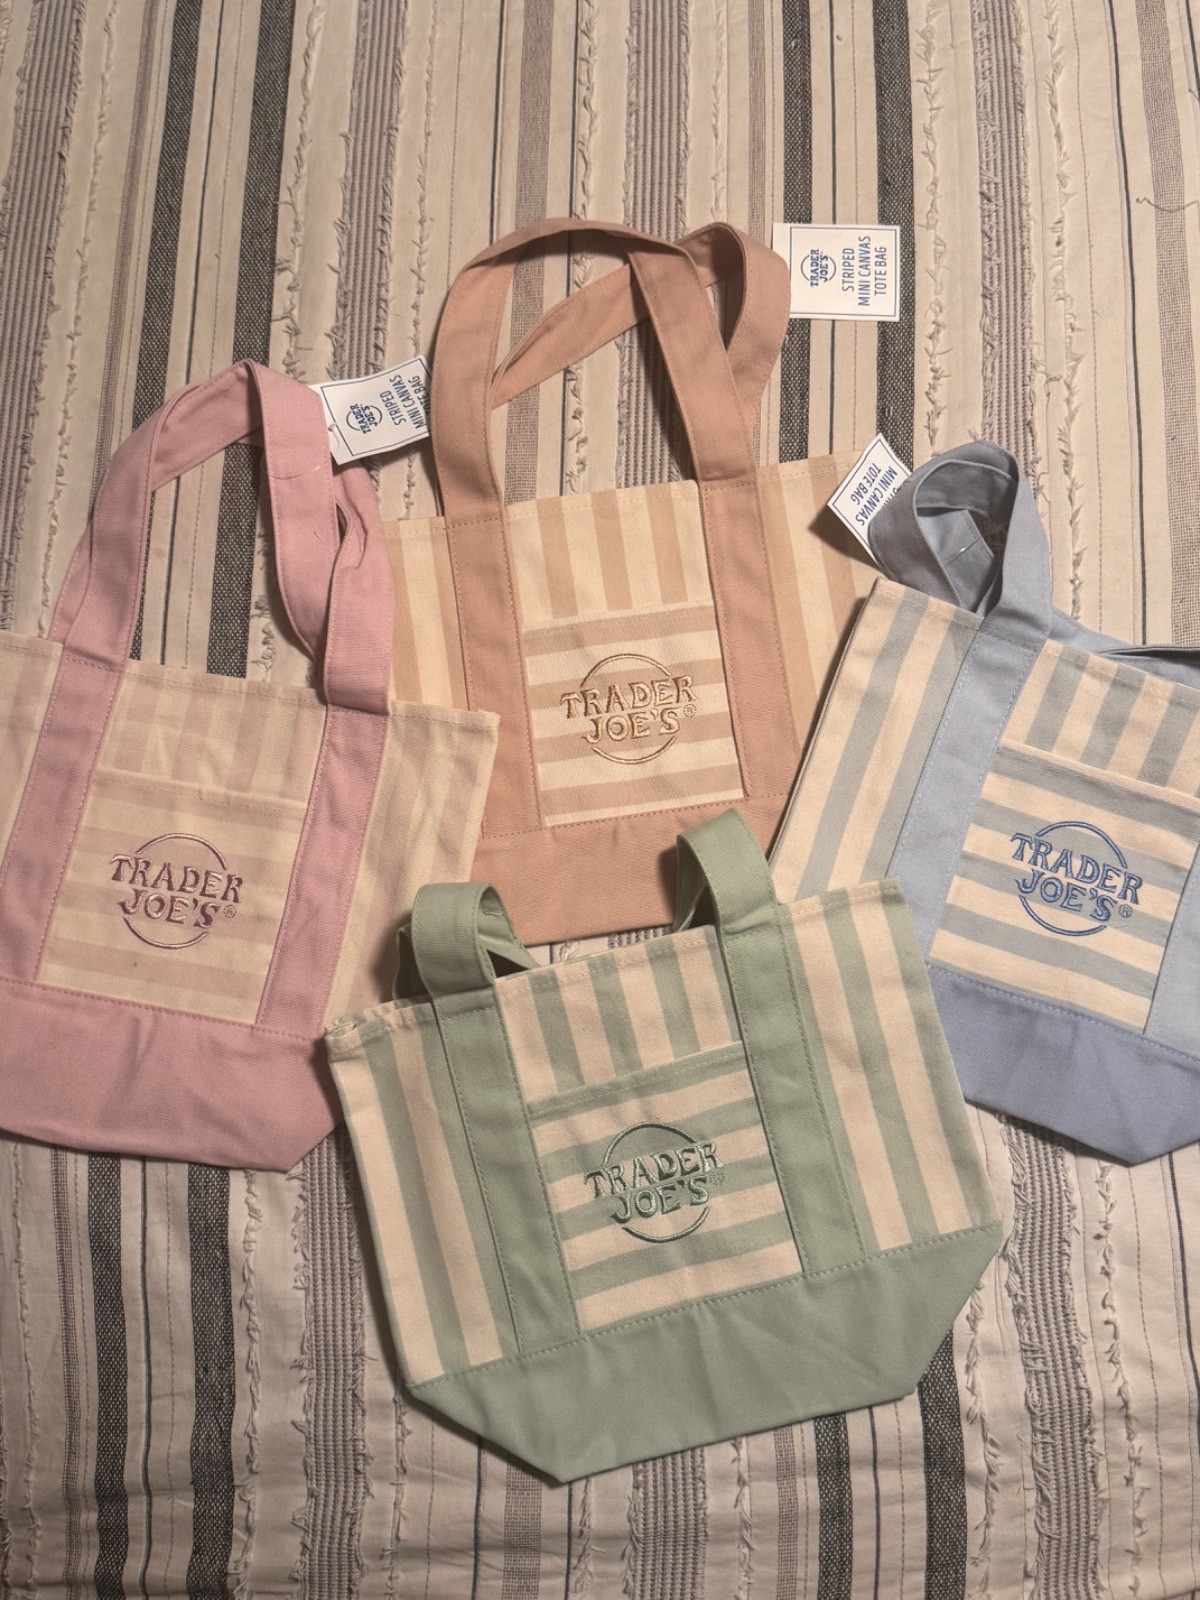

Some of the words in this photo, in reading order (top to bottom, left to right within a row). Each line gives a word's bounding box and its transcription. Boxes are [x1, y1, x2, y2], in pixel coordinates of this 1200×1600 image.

[810, 249, 819, 287] TRADER
[820, 254, 828, 283] JOE'S
[842, 248, 855, 292] STRIPED
[858, 236, 871, 277] CANVAS
[874, 246, 887, 267] BAG
[858, 280, 871, 307] MINI
[874, 270, 887, 296] TOTE
[389, 375, 415, 408] CANVAS
[408, 375, 426, 394] BAG
[350, 403, 372, 435] TRADER
[380, 390, 406, 426] STRIPED
[407, 407, 426, 429] MINI
[863, 462, 882, 488] TOTE
[879, 466, 898, 492] MINI
[850, 483, 869, 506] BAG
[855, 487, 884, 526] CANVAS
[560, 675, 698, 719] TRADER
[110, 853, 243, 903] TRADER
[1010, 832, 1143, 905] TRADER
[584, 1142, 723, 1198] TRADER
